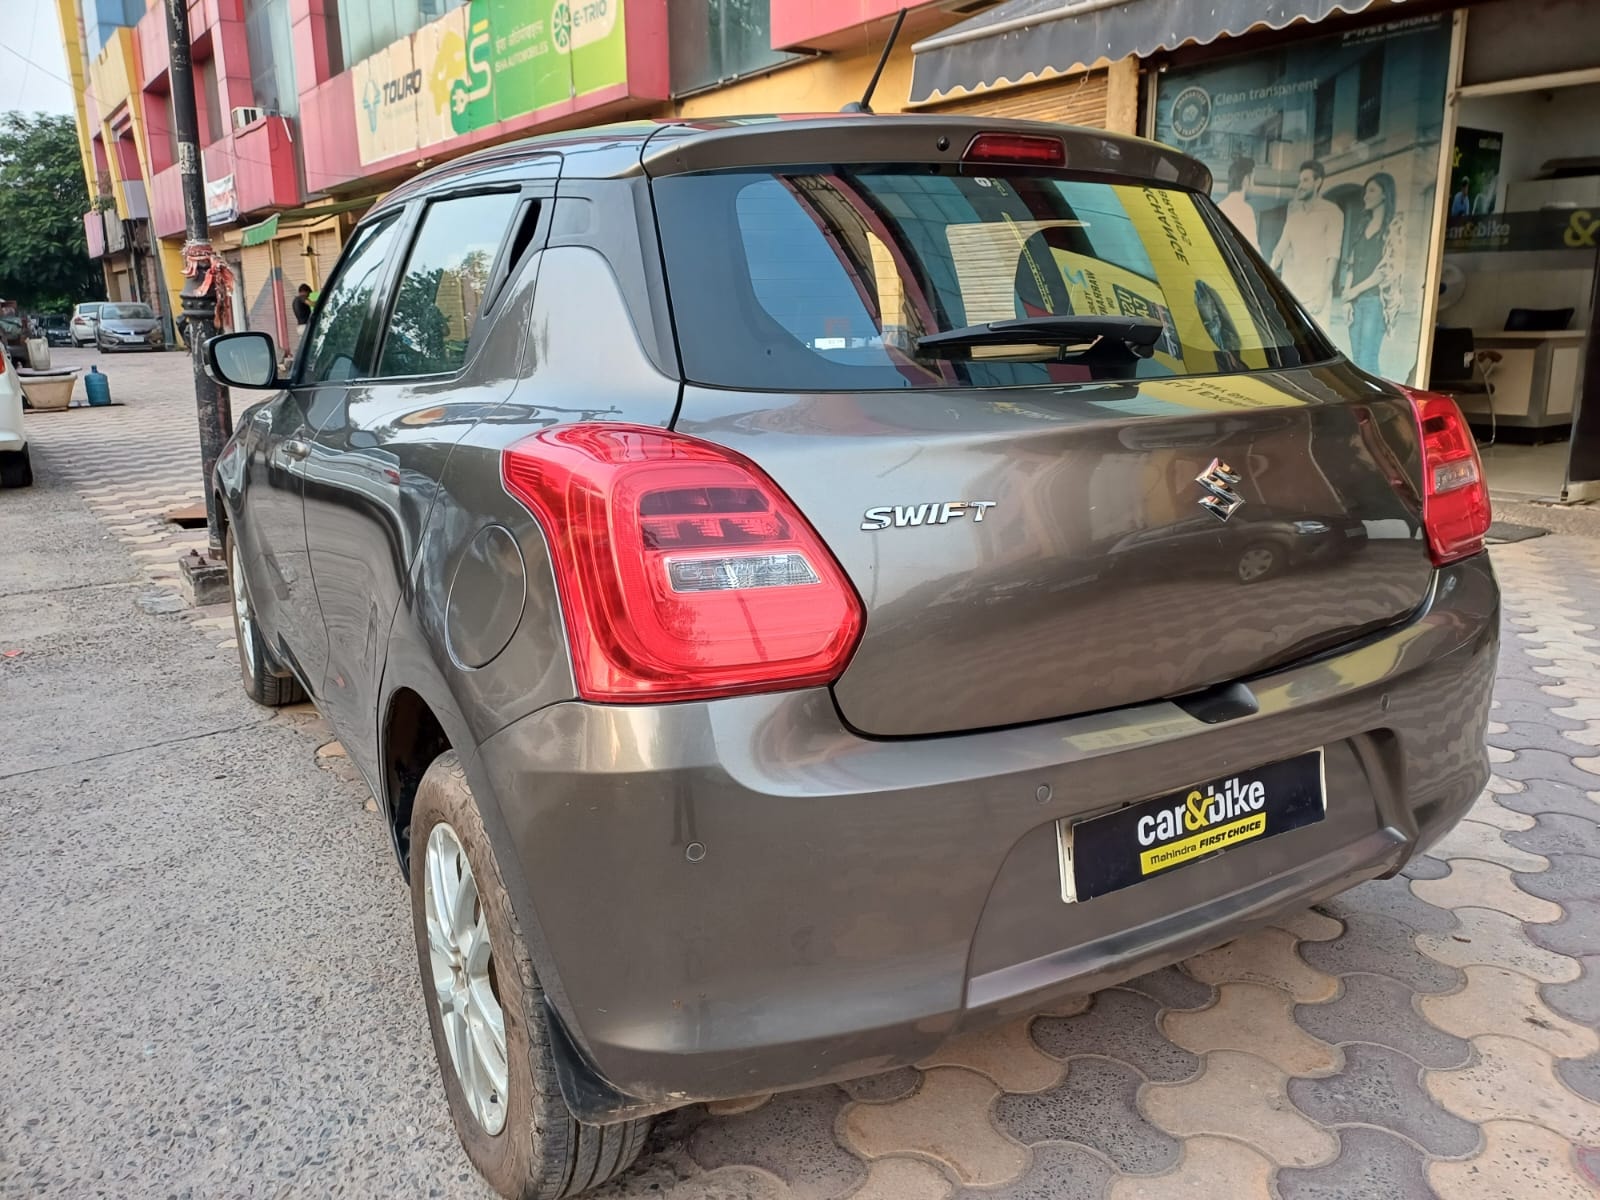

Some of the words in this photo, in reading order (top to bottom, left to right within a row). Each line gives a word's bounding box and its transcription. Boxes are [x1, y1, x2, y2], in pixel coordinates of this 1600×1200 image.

[573, 0, 607, 27] E-TRIO
[383, 68, 422, 107] TOURO
[1214, 91, 1246, 105] Clean
[1250, 78, 1318, 99] transparent
[1447, 220, 1510, 240] ar&bike
[860, 500, 997, 531] SWIFT
[1137, 777, 1265, 846] car&bike
[1150, 843, 1197, 865] Mahindra
[1199, 830, 1227, 849] FIRST
[1227, 819, 1262, 839] CHOICE
